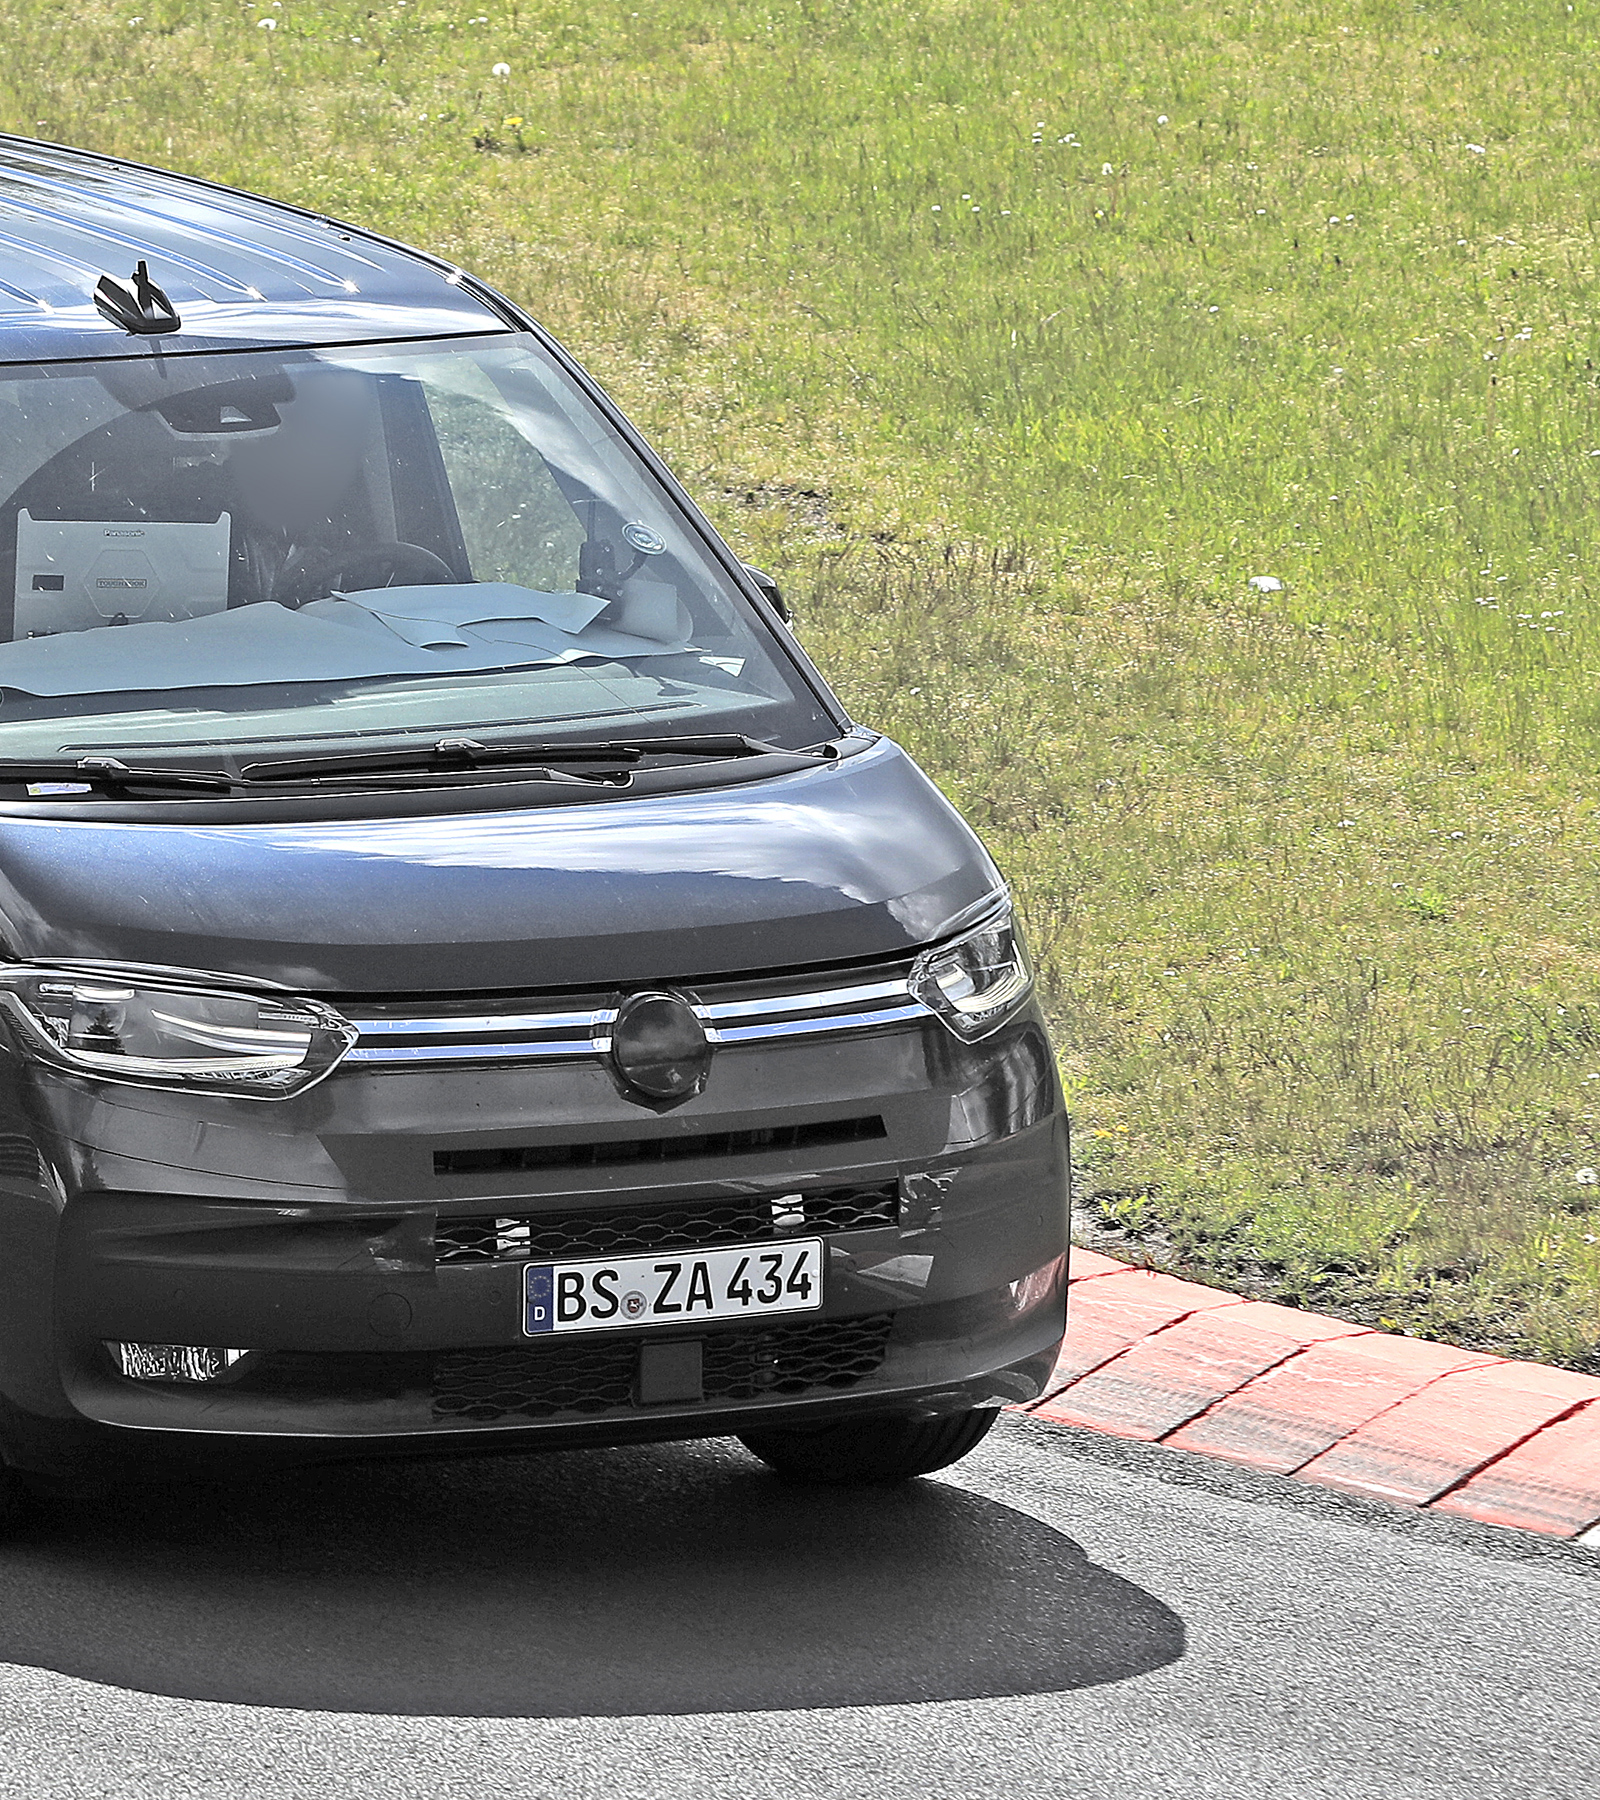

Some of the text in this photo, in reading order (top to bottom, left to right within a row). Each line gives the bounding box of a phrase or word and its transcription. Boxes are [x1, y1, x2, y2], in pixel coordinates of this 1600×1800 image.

[103, 528, 146, 538] Panasonic
[557, 1251, 812, 1322] BS ZA 434
[534, 1305, 546, 1321] D
